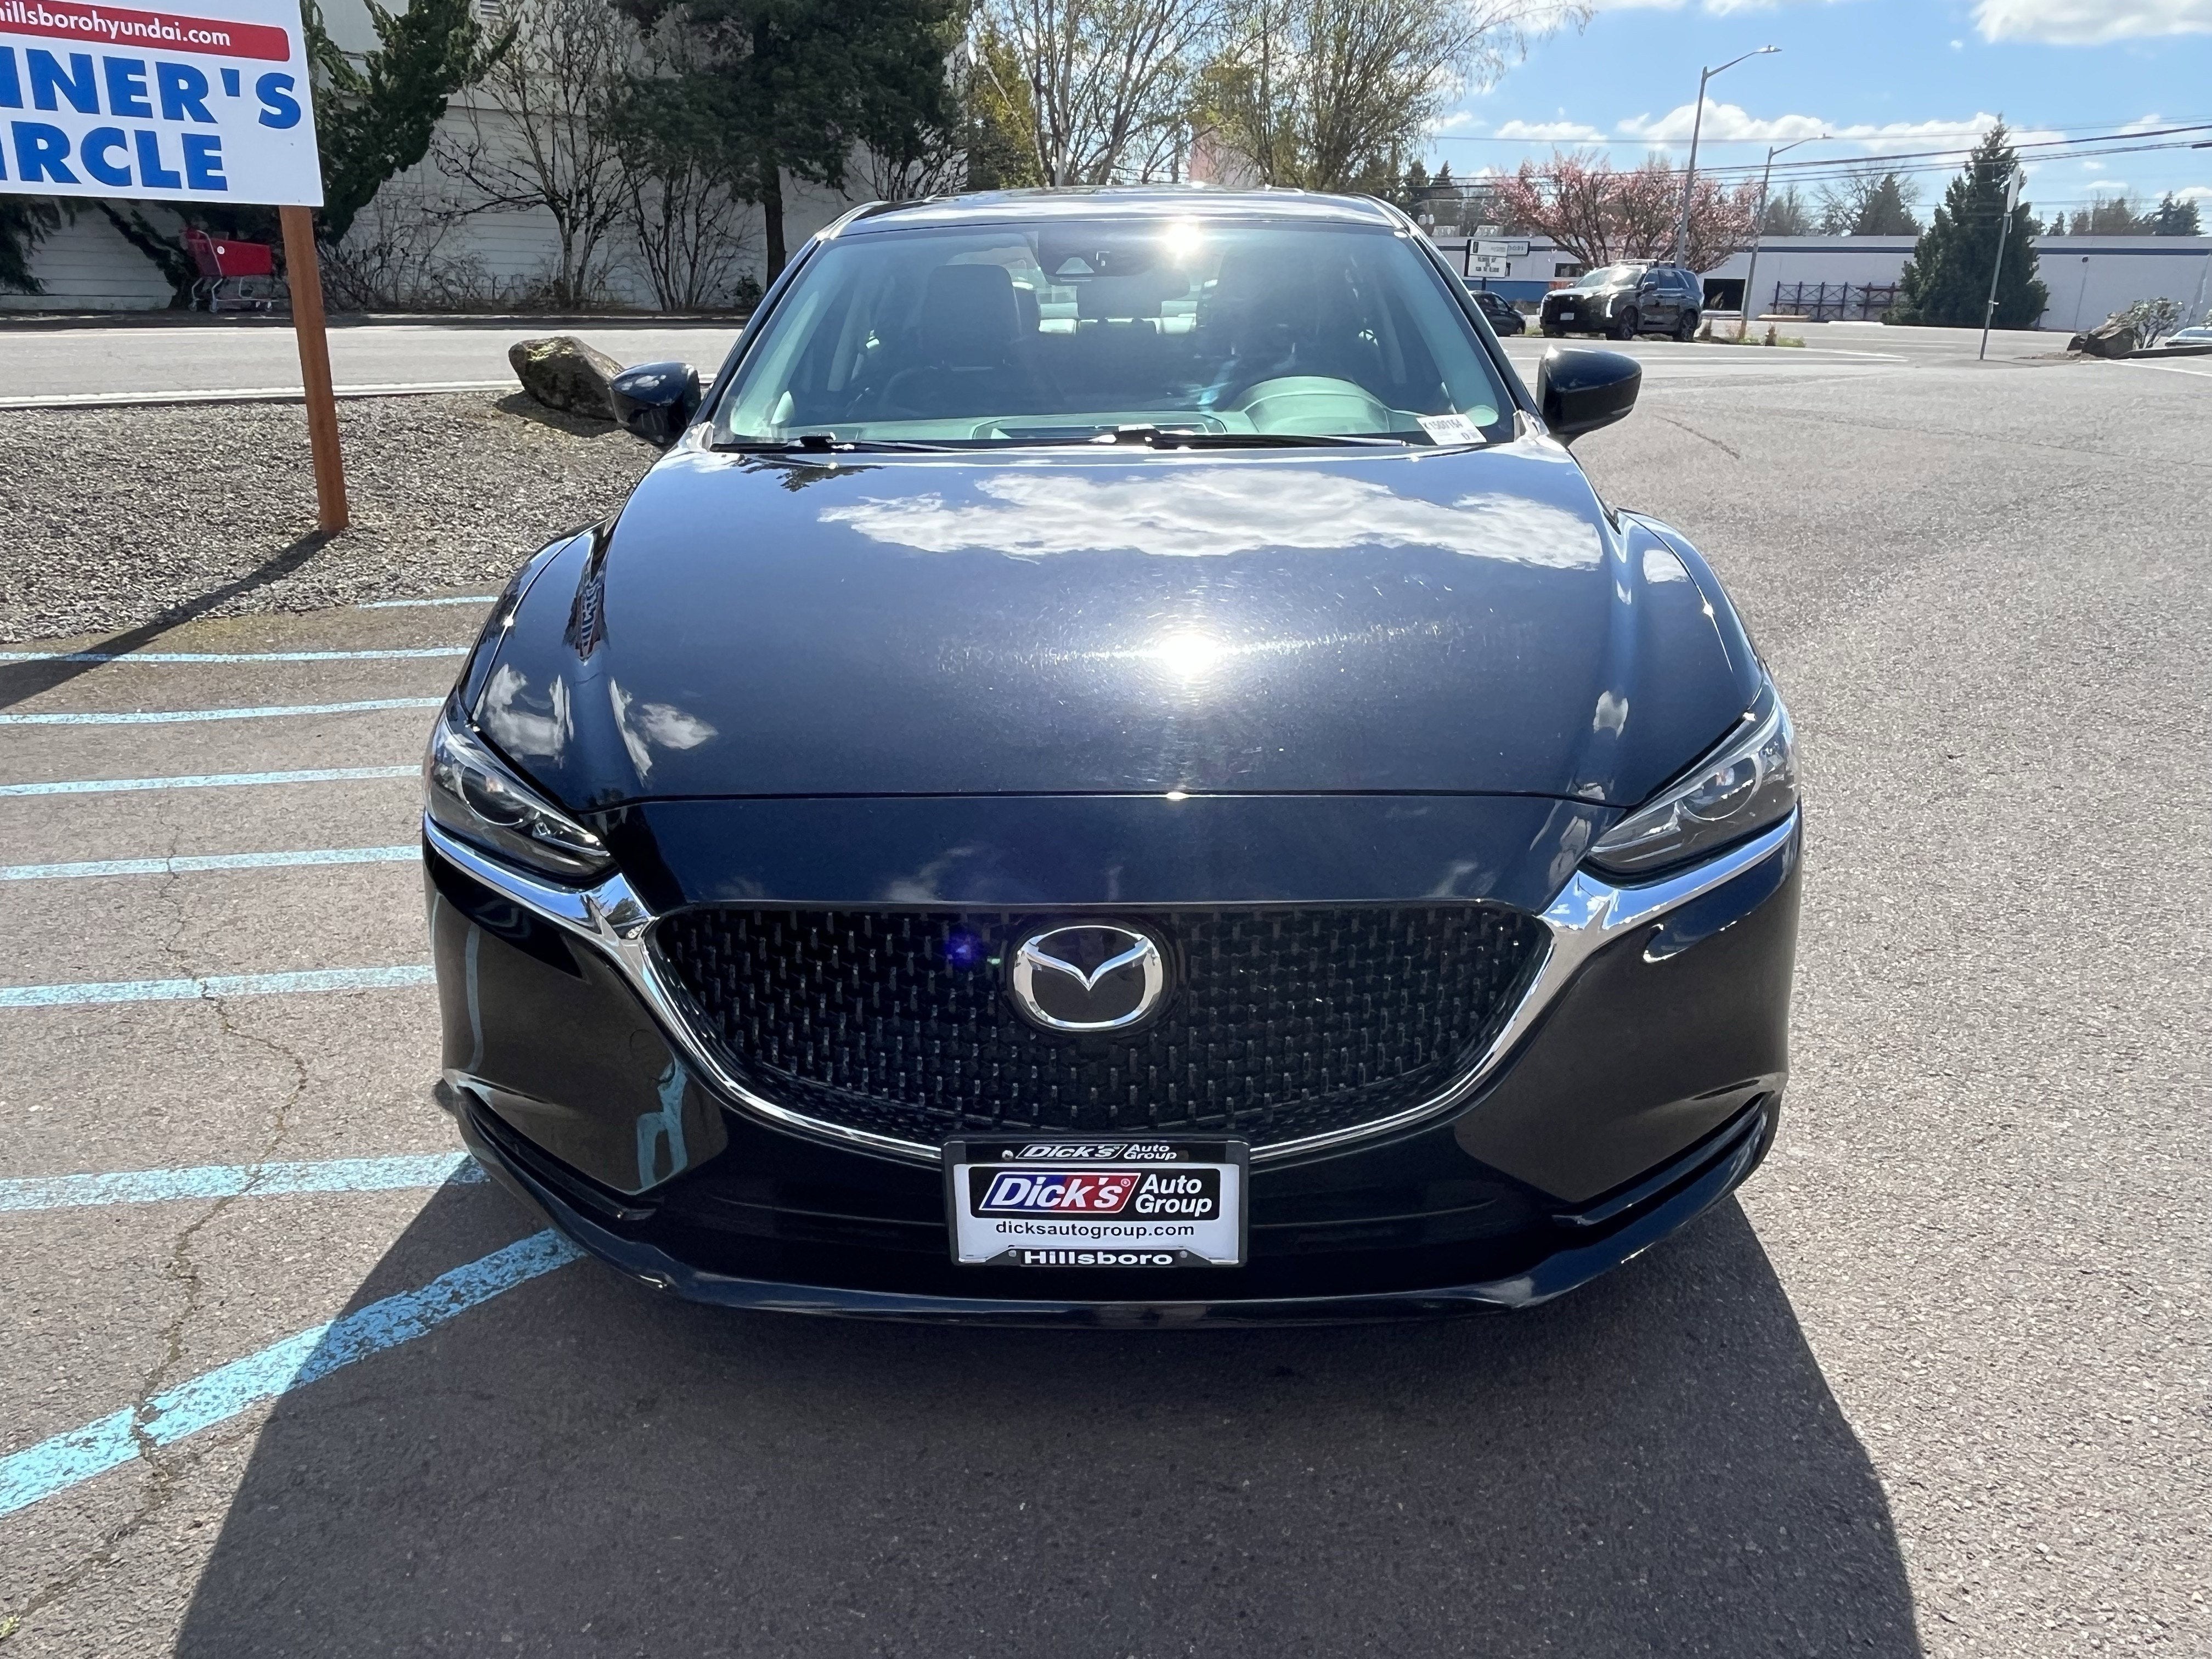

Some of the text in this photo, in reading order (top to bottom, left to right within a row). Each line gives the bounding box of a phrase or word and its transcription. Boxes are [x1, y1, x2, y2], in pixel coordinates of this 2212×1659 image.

[0, 121, 228, 191] RCLE
[1024, 1145, 1113, 1158] Dick's
[1124, 1152, 1177, 1160] Group
[1126, 1144, 1170, 1152] Auto
[990, 1176, 1123, 1208] Dick's
[1139, 1173, 1202, 1194] Auto
[1135, 1194, 1212, 1217] Group
[996, 1221, 1194, 1239] dicksautogroup.com
[1024, 1251, 1173, 1265] Hillsboro
